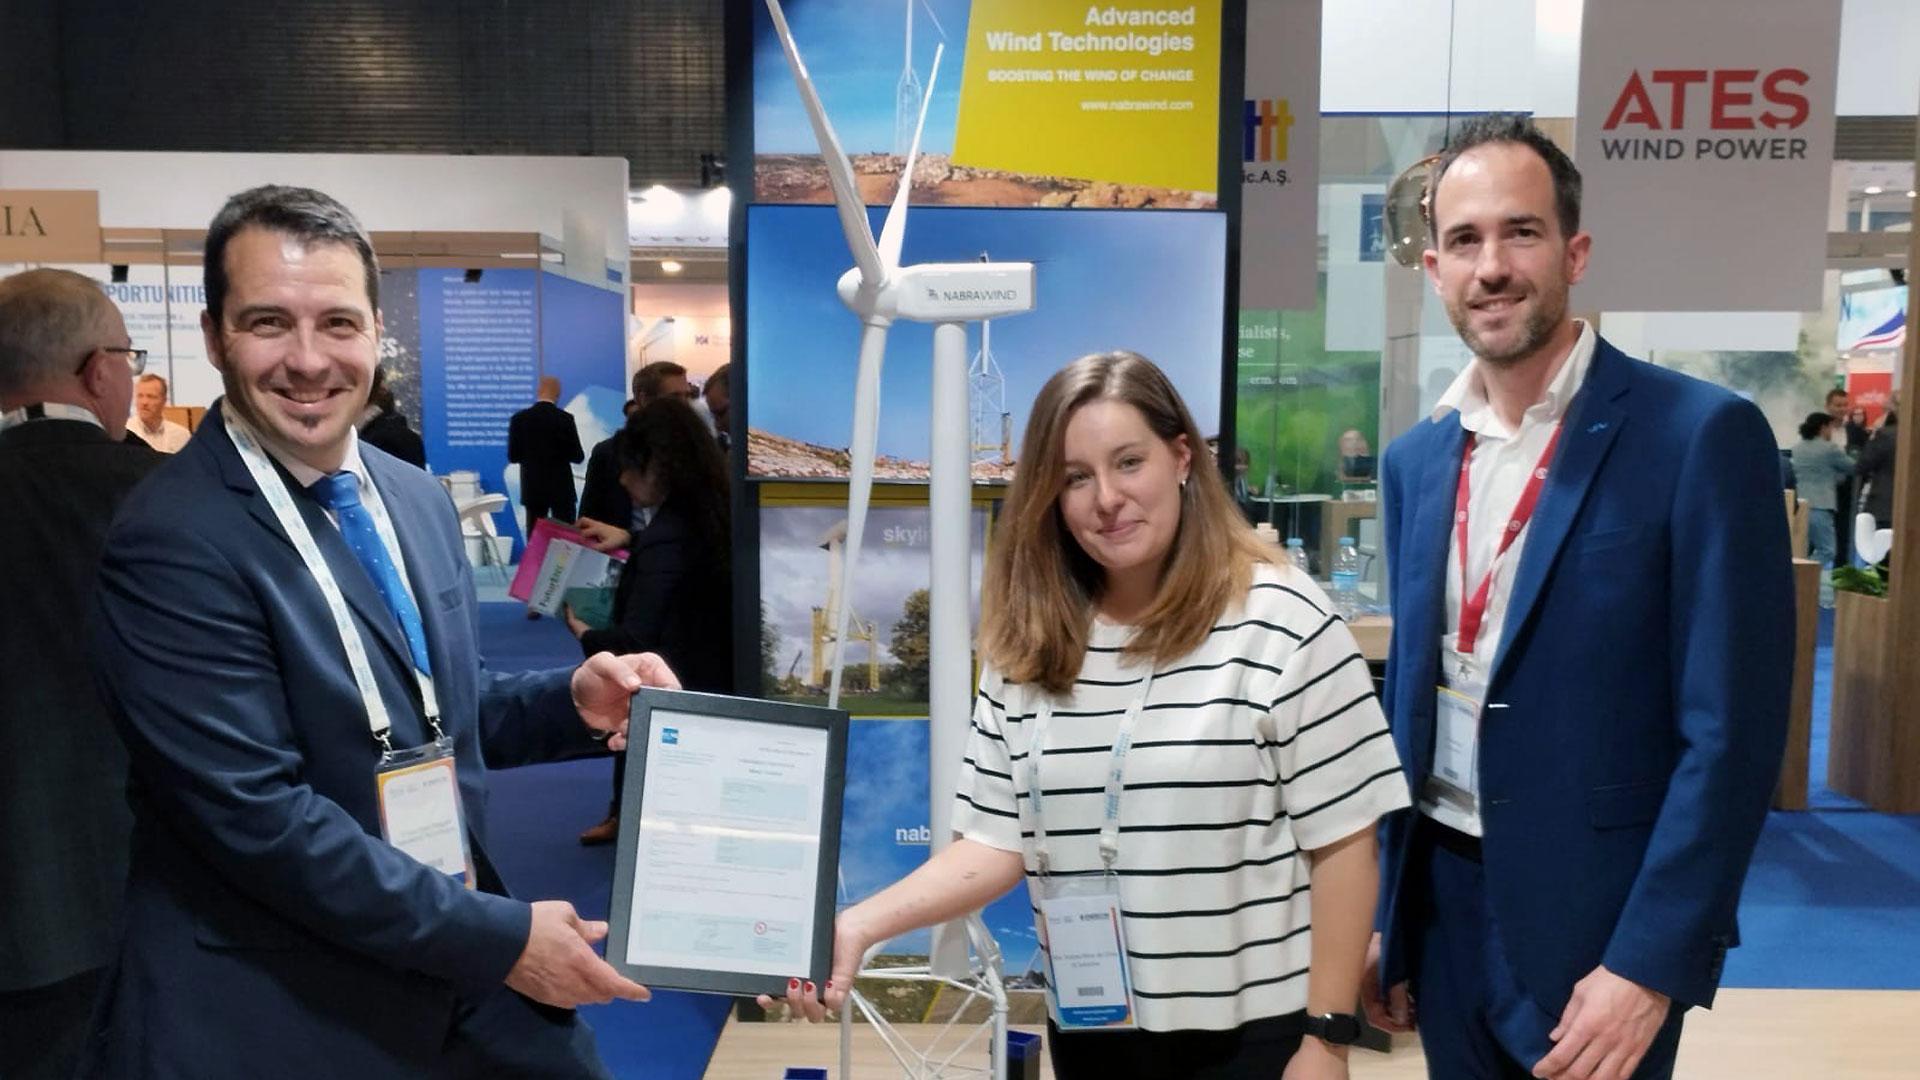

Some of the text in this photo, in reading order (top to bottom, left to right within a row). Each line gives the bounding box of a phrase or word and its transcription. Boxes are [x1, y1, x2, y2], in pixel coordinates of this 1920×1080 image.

[1085, 6, 1195, 26] Advanced
[986, 32, 1194, 56] Wind Technologies
[988, 69, 1194, 82] BOOSTING THE WIND OF CHANGE
[1080, 99, 1194, 112] www.nabrawind.com
[1603, 68, 1809, 130] ATES
[1602, 138, 1807, 160] WIND POWER
[943, 290, 1017, 302] NABRAWIND
[883, 525, 931, 546] skyli
